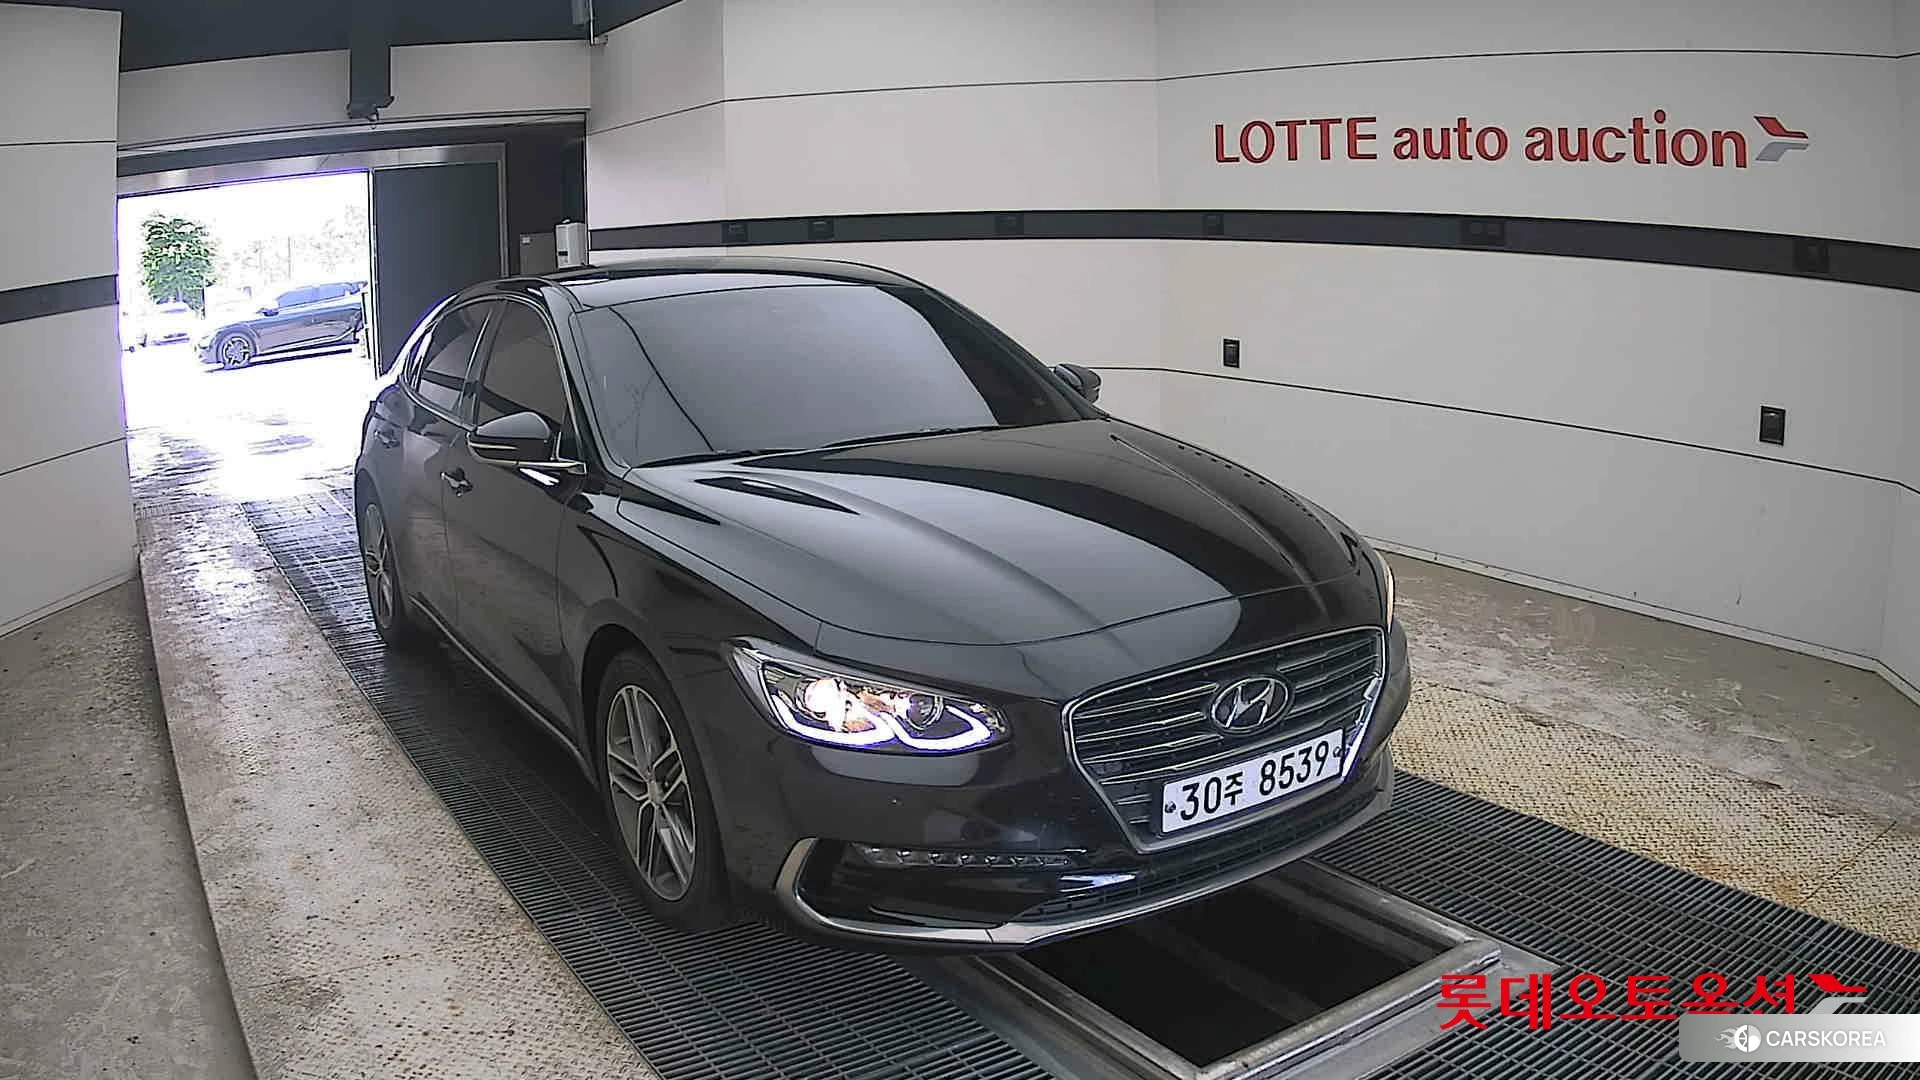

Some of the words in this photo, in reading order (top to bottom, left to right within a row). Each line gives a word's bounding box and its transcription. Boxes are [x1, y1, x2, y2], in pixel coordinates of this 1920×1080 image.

[1214, 116, 1378, 163] LOTTE
[1393, 117, 1508, 161] auto
[1525, 110, 1748, 169] auction
[1180, 772, 1243, 821] 30주
[1259, 741, 1330, 796] 8539
